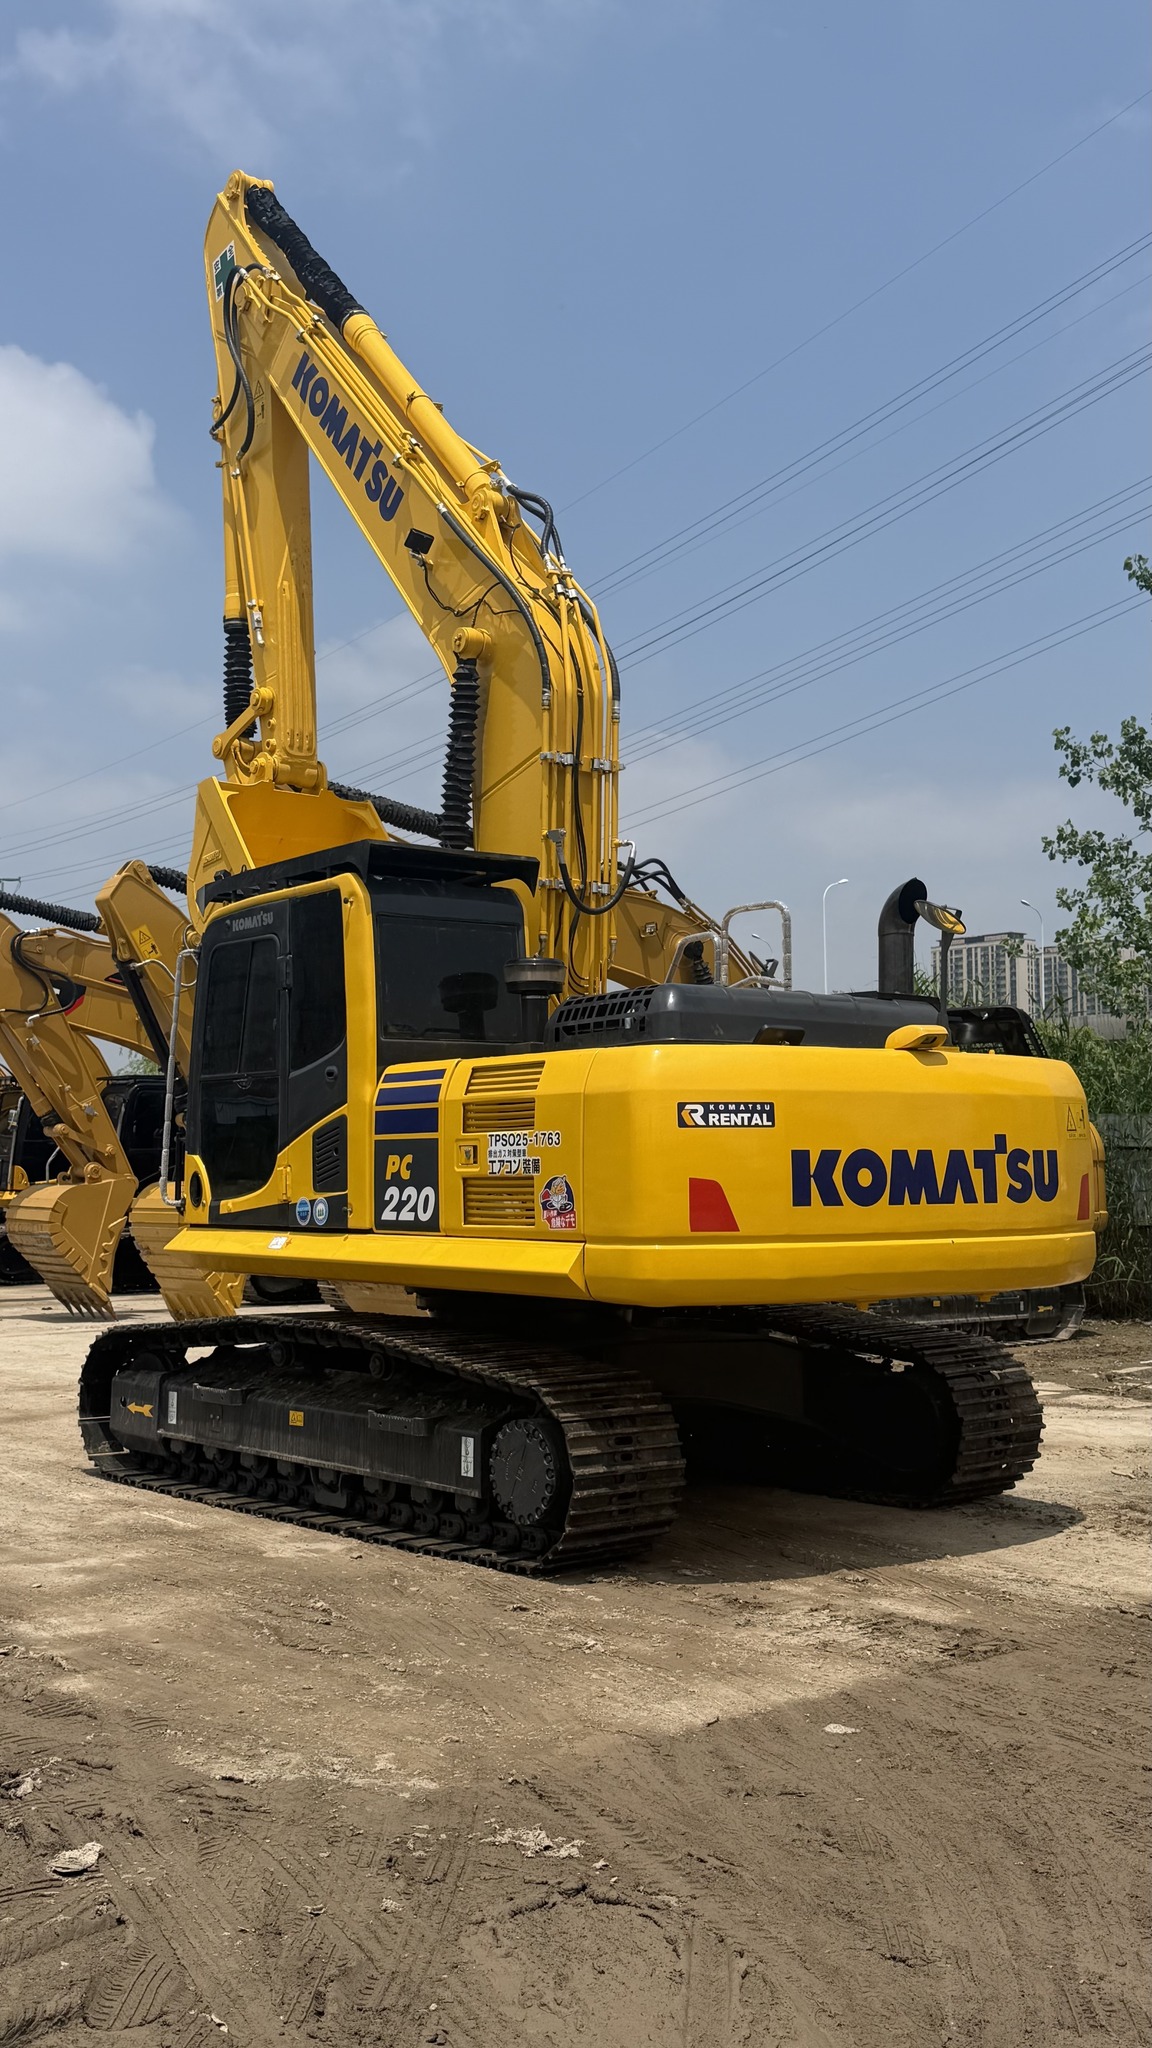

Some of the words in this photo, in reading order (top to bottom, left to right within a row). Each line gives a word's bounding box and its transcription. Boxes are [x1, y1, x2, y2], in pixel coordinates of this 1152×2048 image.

[291, 351, 405, 522] KOMATSU
[232, 911, 274, 932] KOMATSU
[708, 1113, 773, 1126] RENTAL
[385, 1154, 413, 1180] PC
[791, 1134, 1059, 1207] KOMATSU
[381, 1186, 435, 1221] 220
